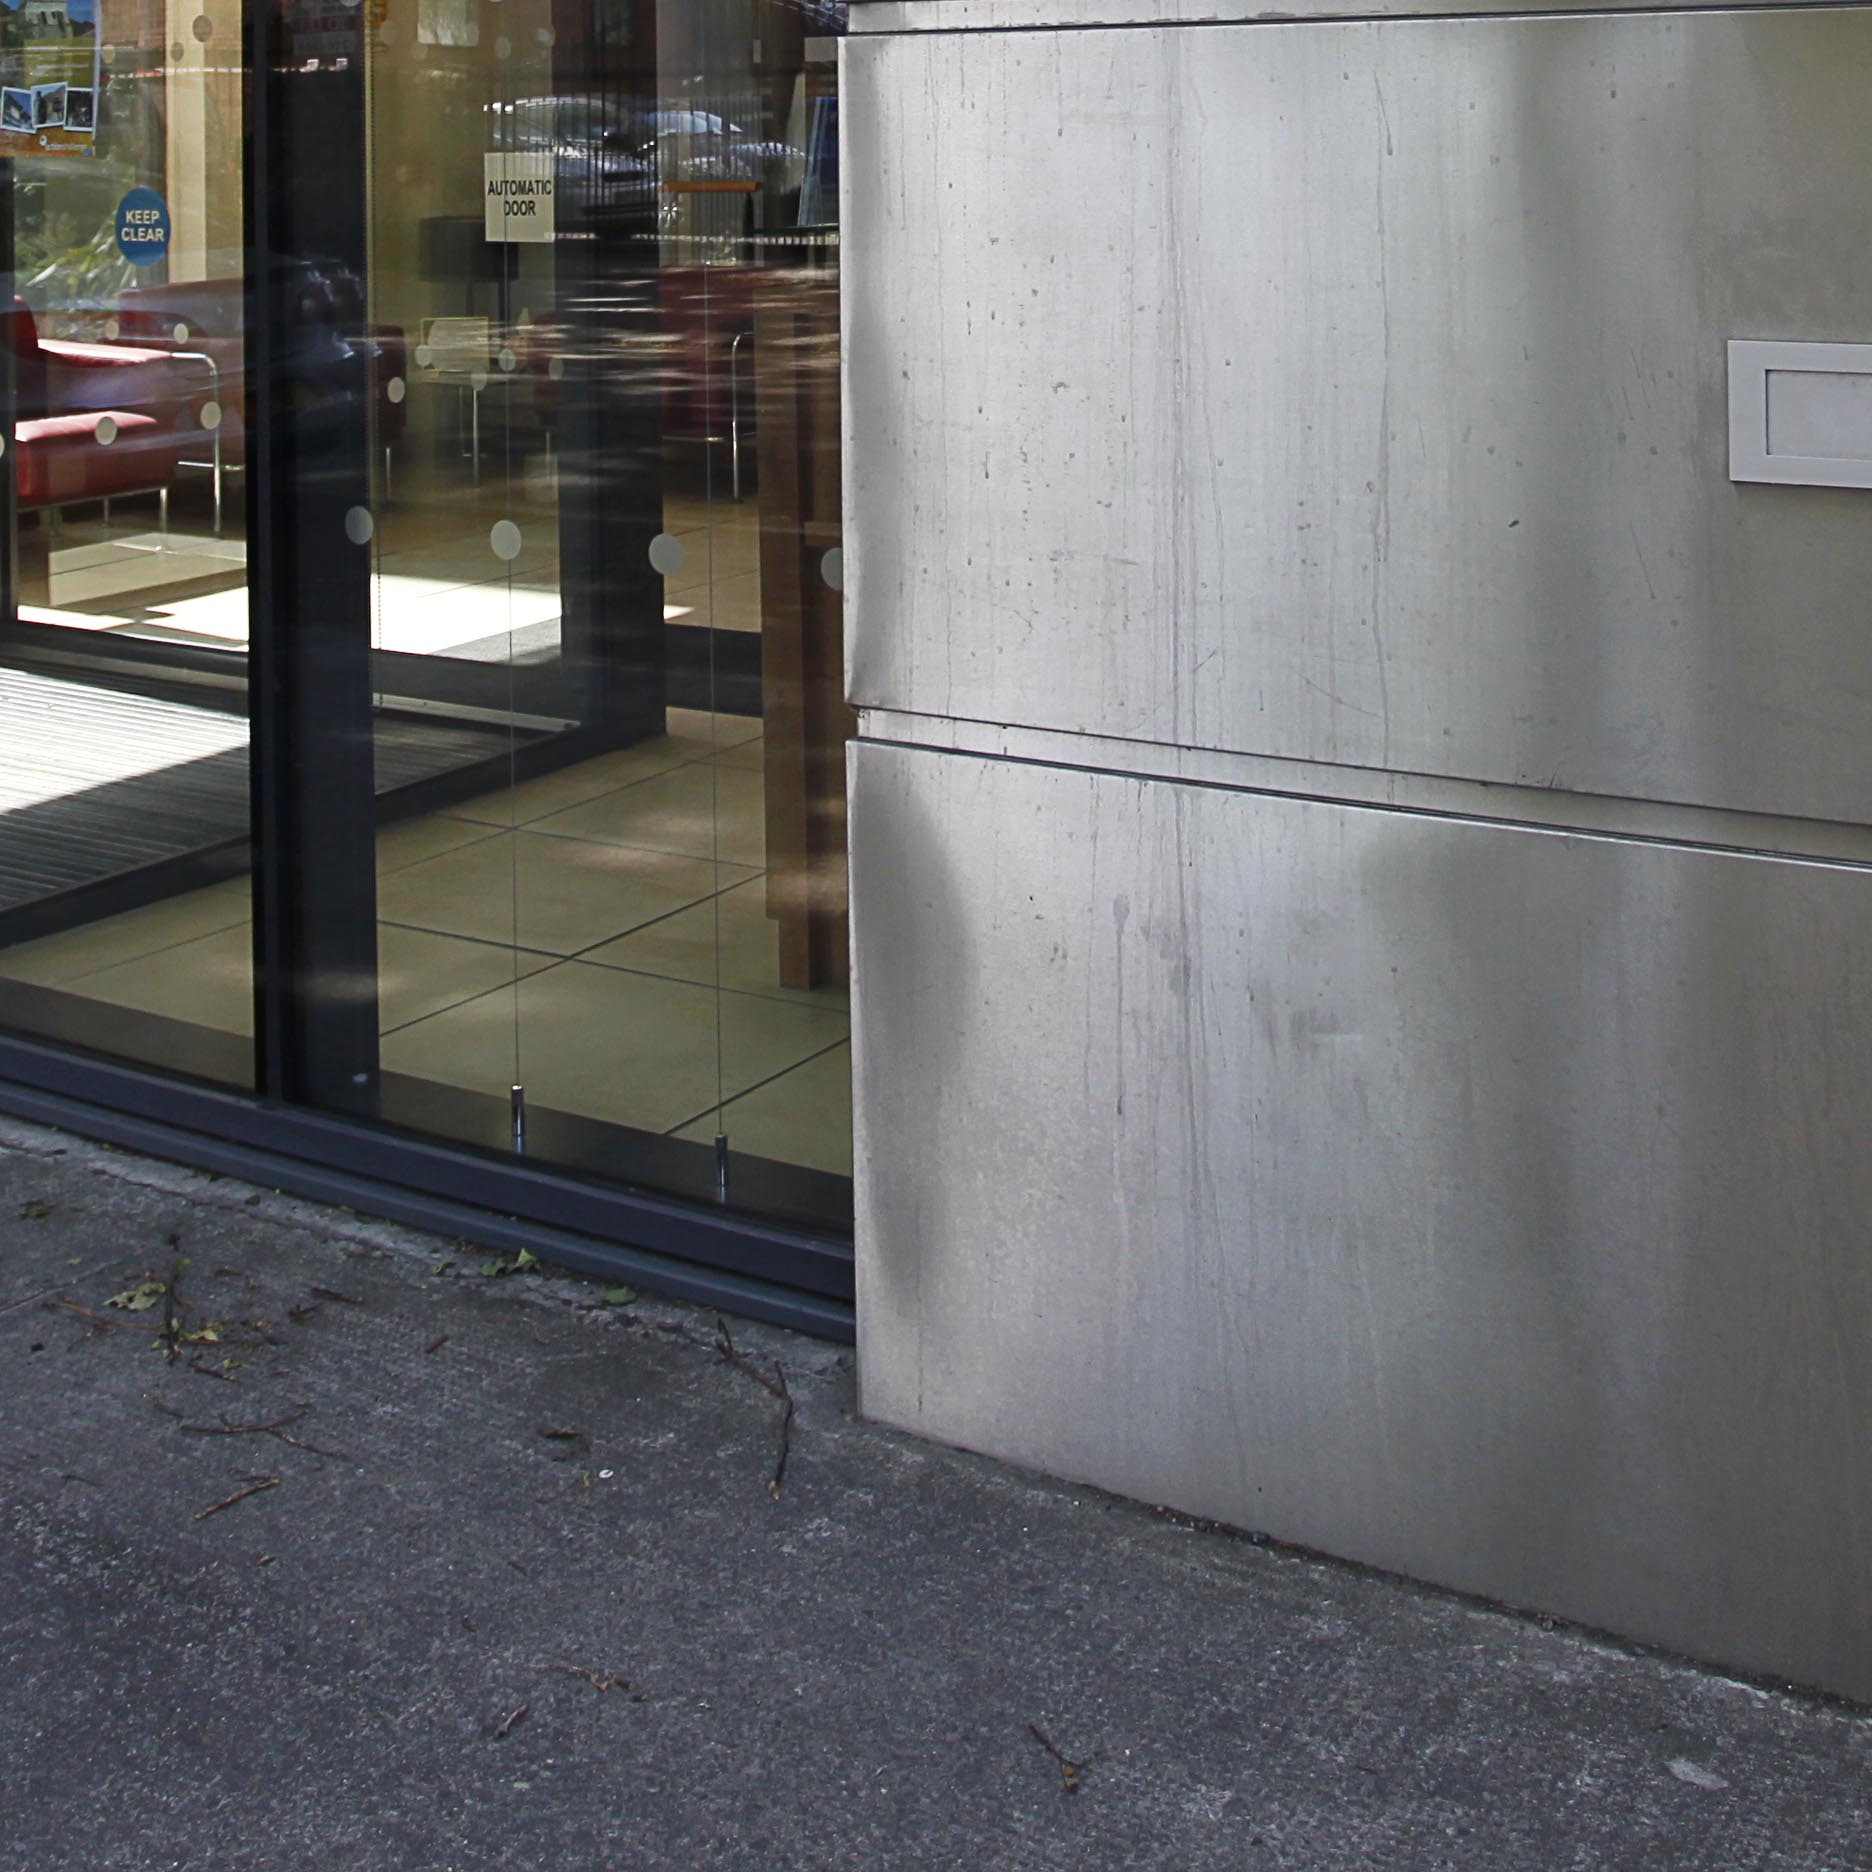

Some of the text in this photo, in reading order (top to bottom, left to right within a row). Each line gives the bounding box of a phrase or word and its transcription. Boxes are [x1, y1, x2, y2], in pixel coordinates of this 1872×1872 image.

[488, 179, 552, 196] AUTOMATIC
[503, 200, 536, 216] DOOR
[125, 210, 160, 224] KEEP
[121, 227, 165, 242] CLEAR
